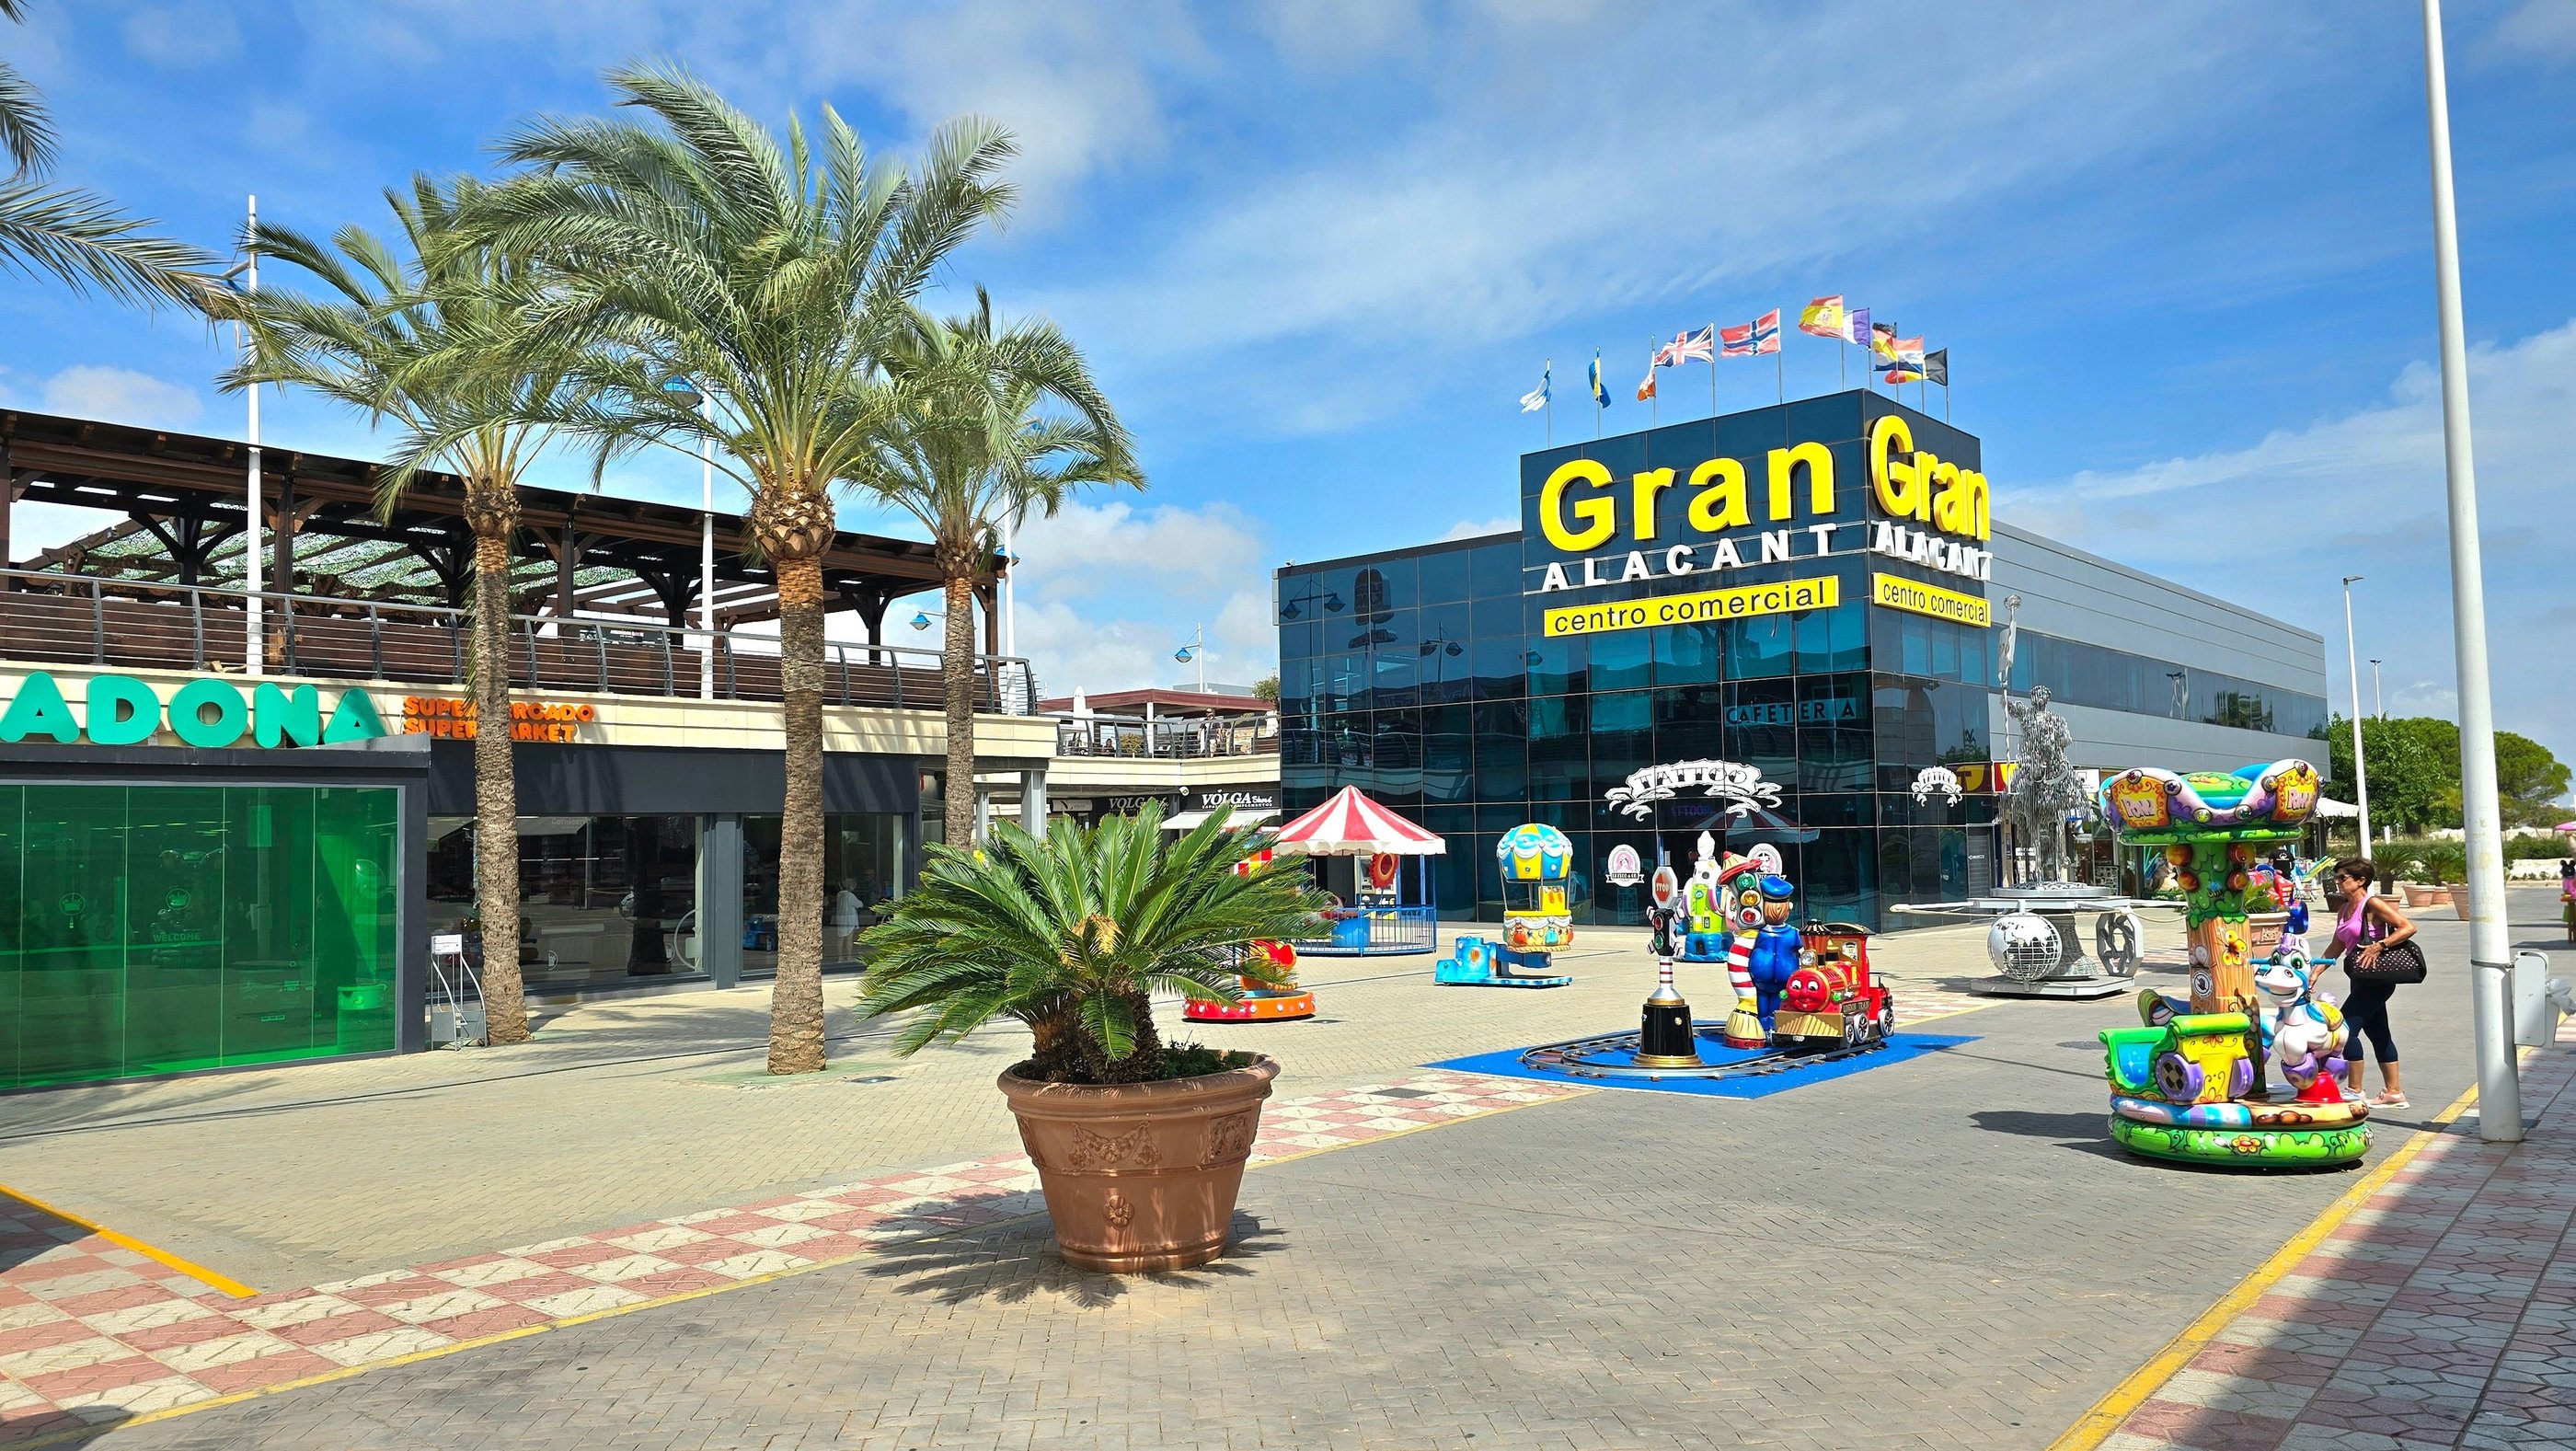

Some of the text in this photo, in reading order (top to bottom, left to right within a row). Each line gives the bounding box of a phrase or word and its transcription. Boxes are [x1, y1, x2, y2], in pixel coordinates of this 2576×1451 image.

[1539, 442, 1835, 552] Gran
[1870, 415, 1991, 541] Gran
[1542, 523, 1837, 592] ALACANT
[1874, 521, 1993, 581] ALACANT
[1555, 581, 1824, 632] centro comercial
[1883, 583, 1988, 624] centro comercial
[1634, 767, 1747, 789] TATTOO
[1656, 882, 1670, 892] STOP
[153, 932, 201, 942] WELCOME
